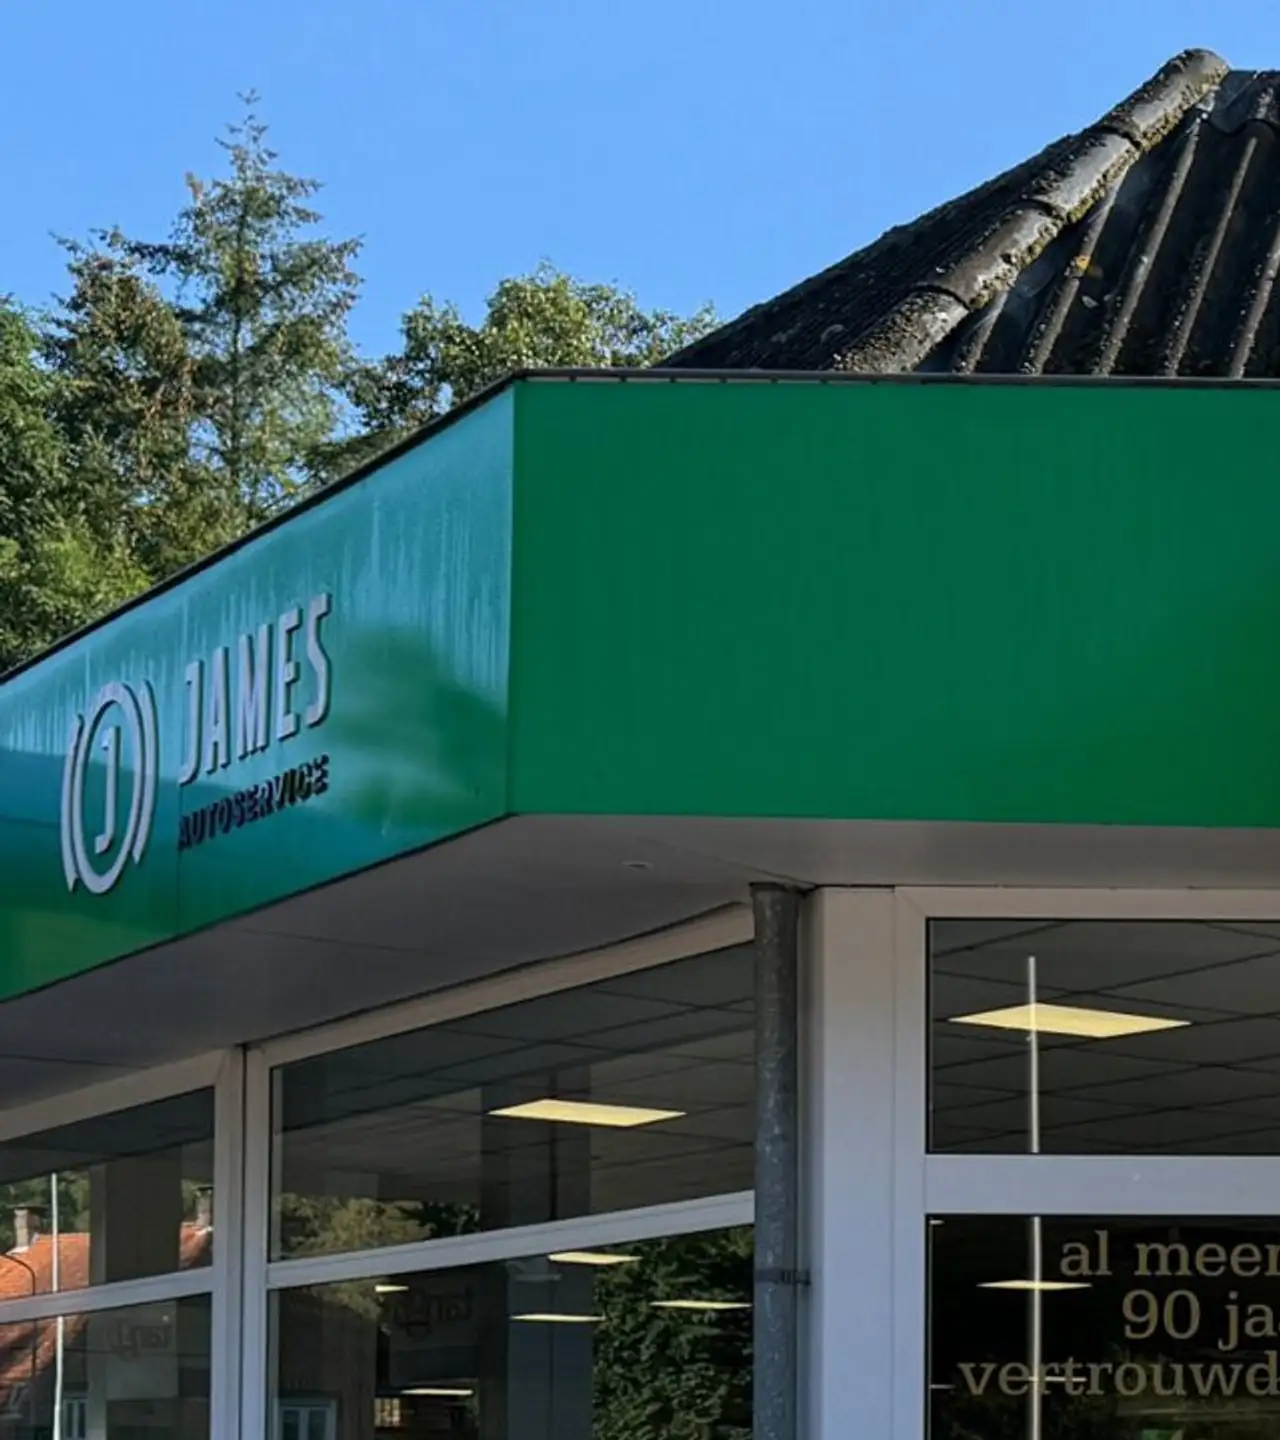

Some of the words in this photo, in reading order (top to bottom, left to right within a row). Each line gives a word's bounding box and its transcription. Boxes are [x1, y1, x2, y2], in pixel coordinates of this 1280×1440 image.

[178, 591, 333, 787] JAMES
[177, 754, 331, 850] AUTOSERVICE
[1059, 1231, 1112, 1278] al
[1122, 1289, 1201, 1341] 90
[958, 1351, 1280, 1397] vertrouwd
